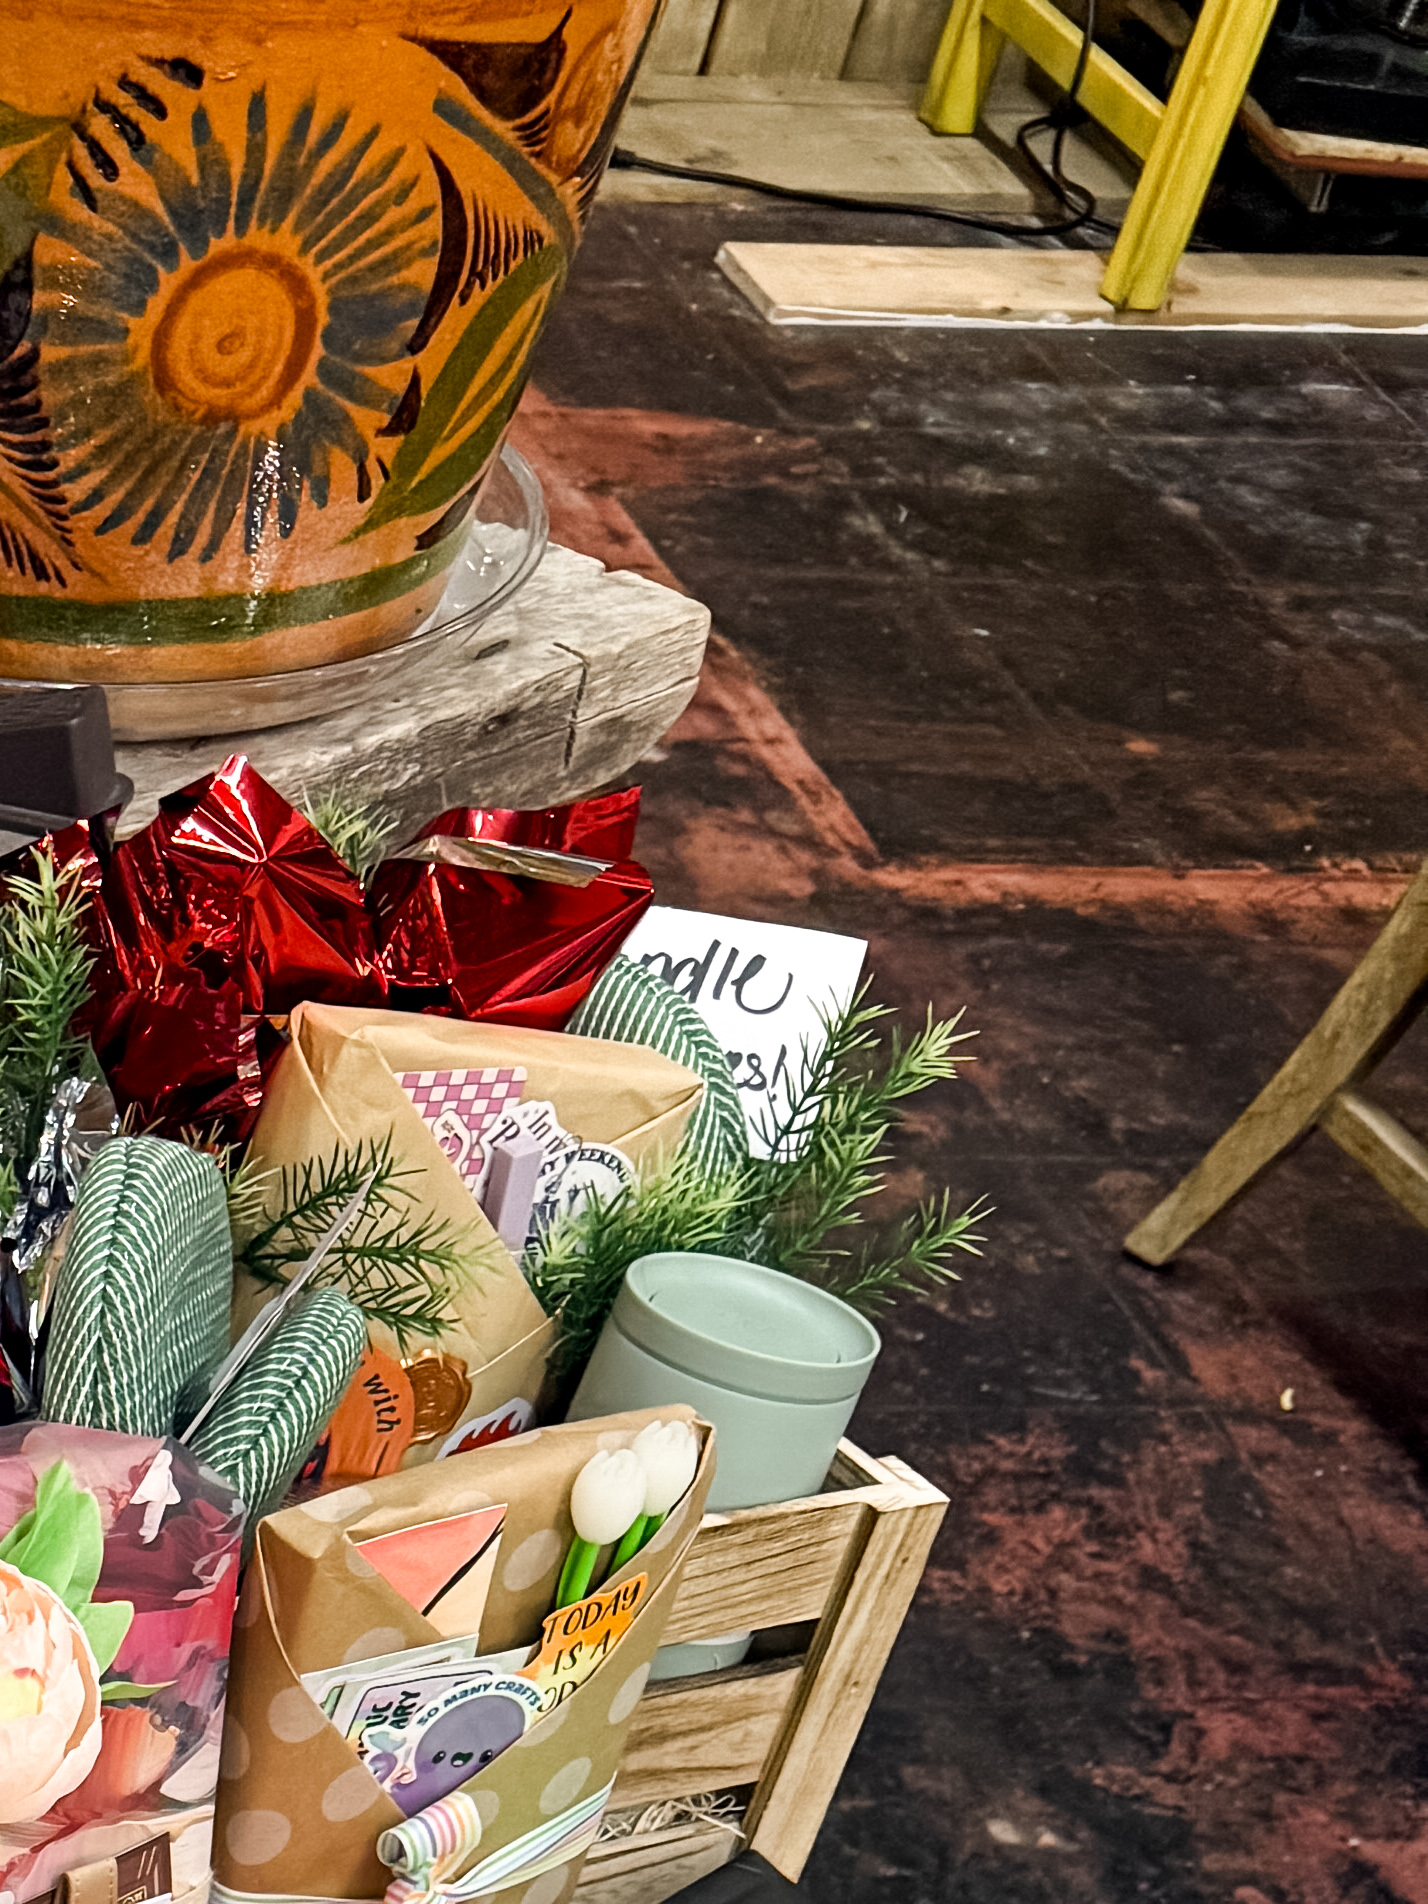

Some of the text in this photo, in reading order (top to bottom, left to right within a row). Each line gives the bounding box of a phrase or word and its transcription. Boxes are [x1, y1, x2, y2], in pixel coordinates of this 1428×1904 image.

[363, 1372, 403, 1434] with
[544, 1579, 642, 1644] TODAY
[552, 1629, 612, 1676] IS A
